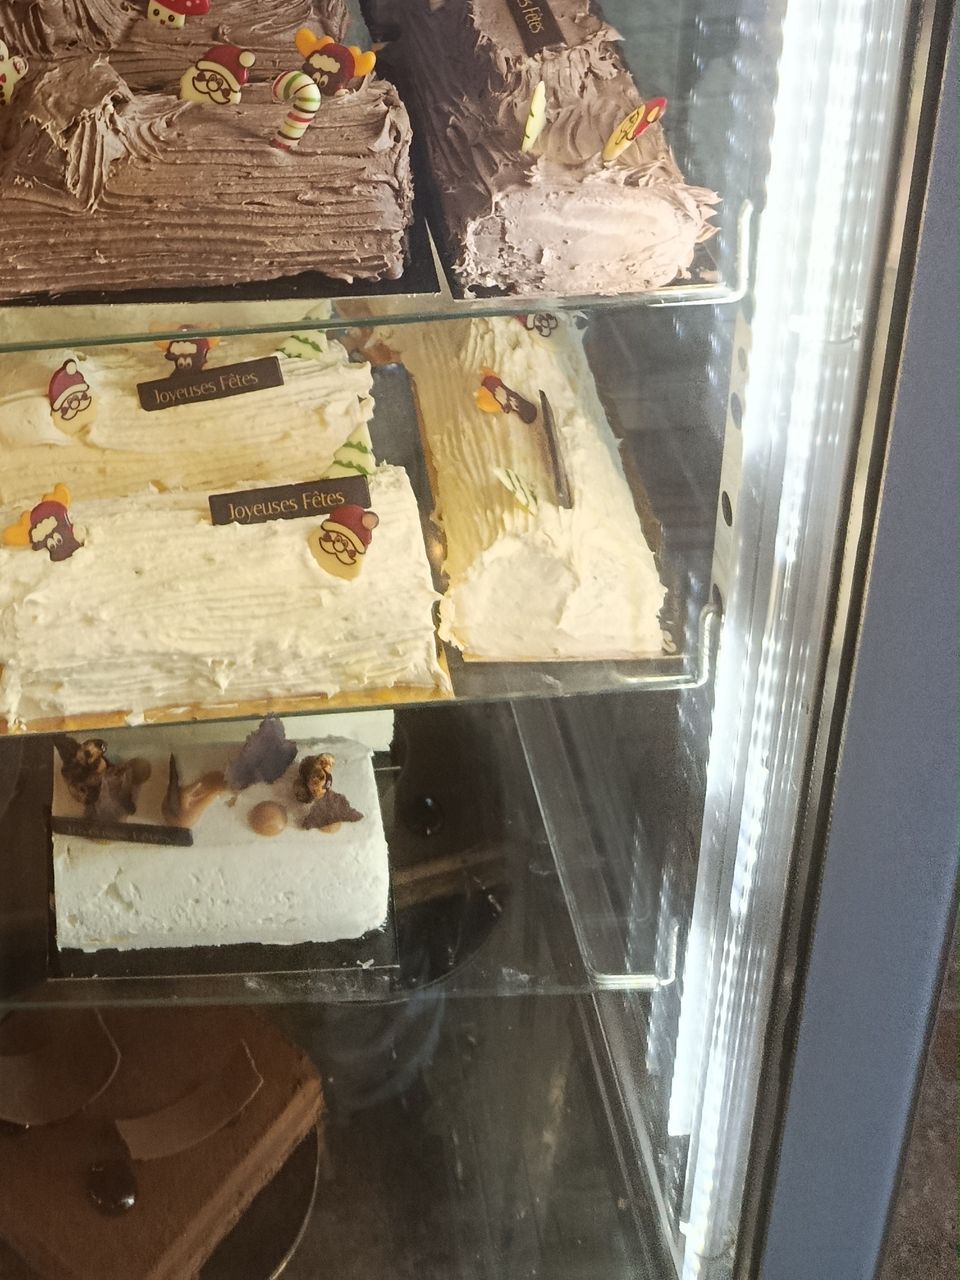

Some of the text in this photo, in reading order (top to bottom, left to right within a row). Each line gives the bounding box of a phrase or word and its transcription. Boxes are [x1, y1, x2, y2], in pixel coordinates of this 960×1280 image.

[153, 370, 259, 405] Joyeuses Fêtes
[227, 489, 346, 523] Joyeuses Fêtes
